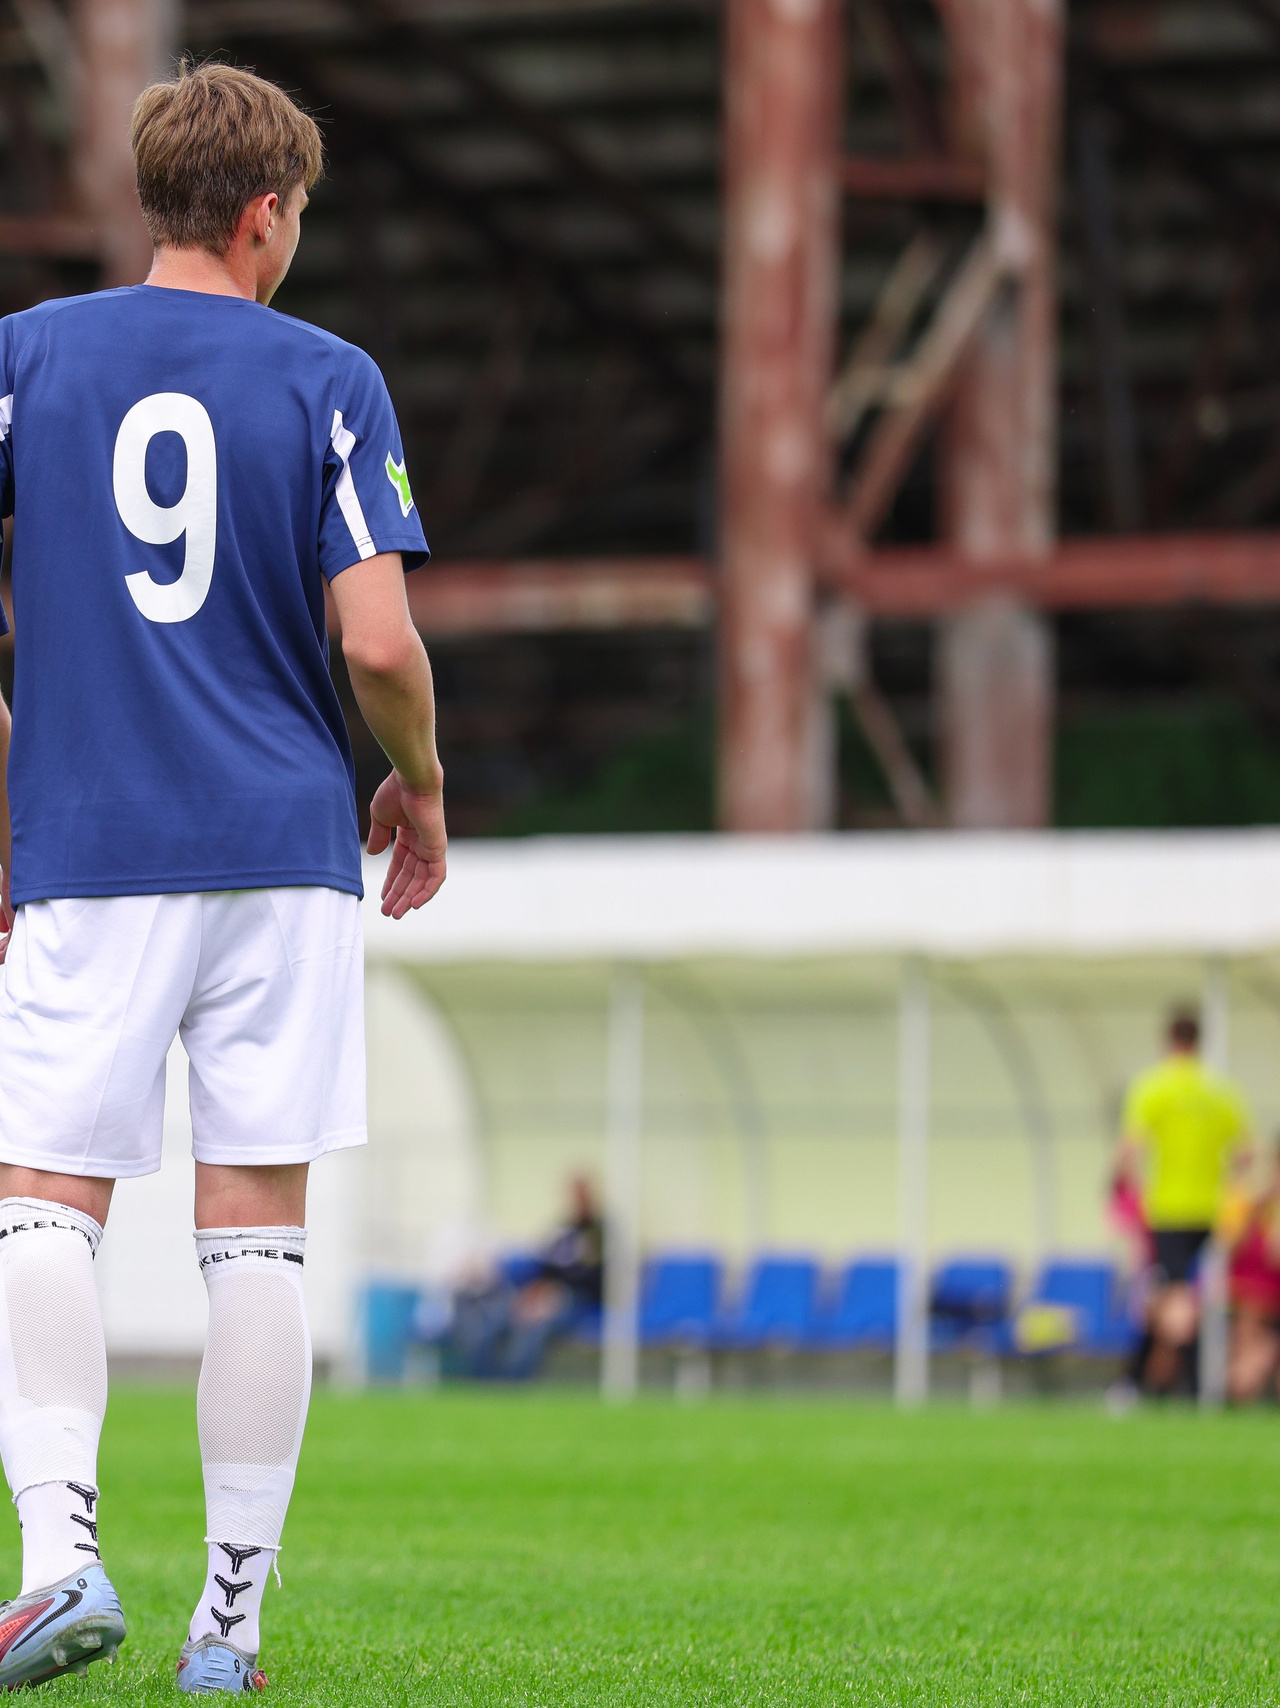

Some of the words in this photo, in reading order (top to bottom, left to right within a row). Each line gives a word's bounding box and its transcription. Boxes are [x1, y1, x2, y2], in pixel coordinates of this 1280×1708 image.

[113, 392, 218, 624] 9
[200, 1249, 279, 1268] KELME
[76, 1578, 88, 1590] 9
[234, 1658, 240, 1674] 9
